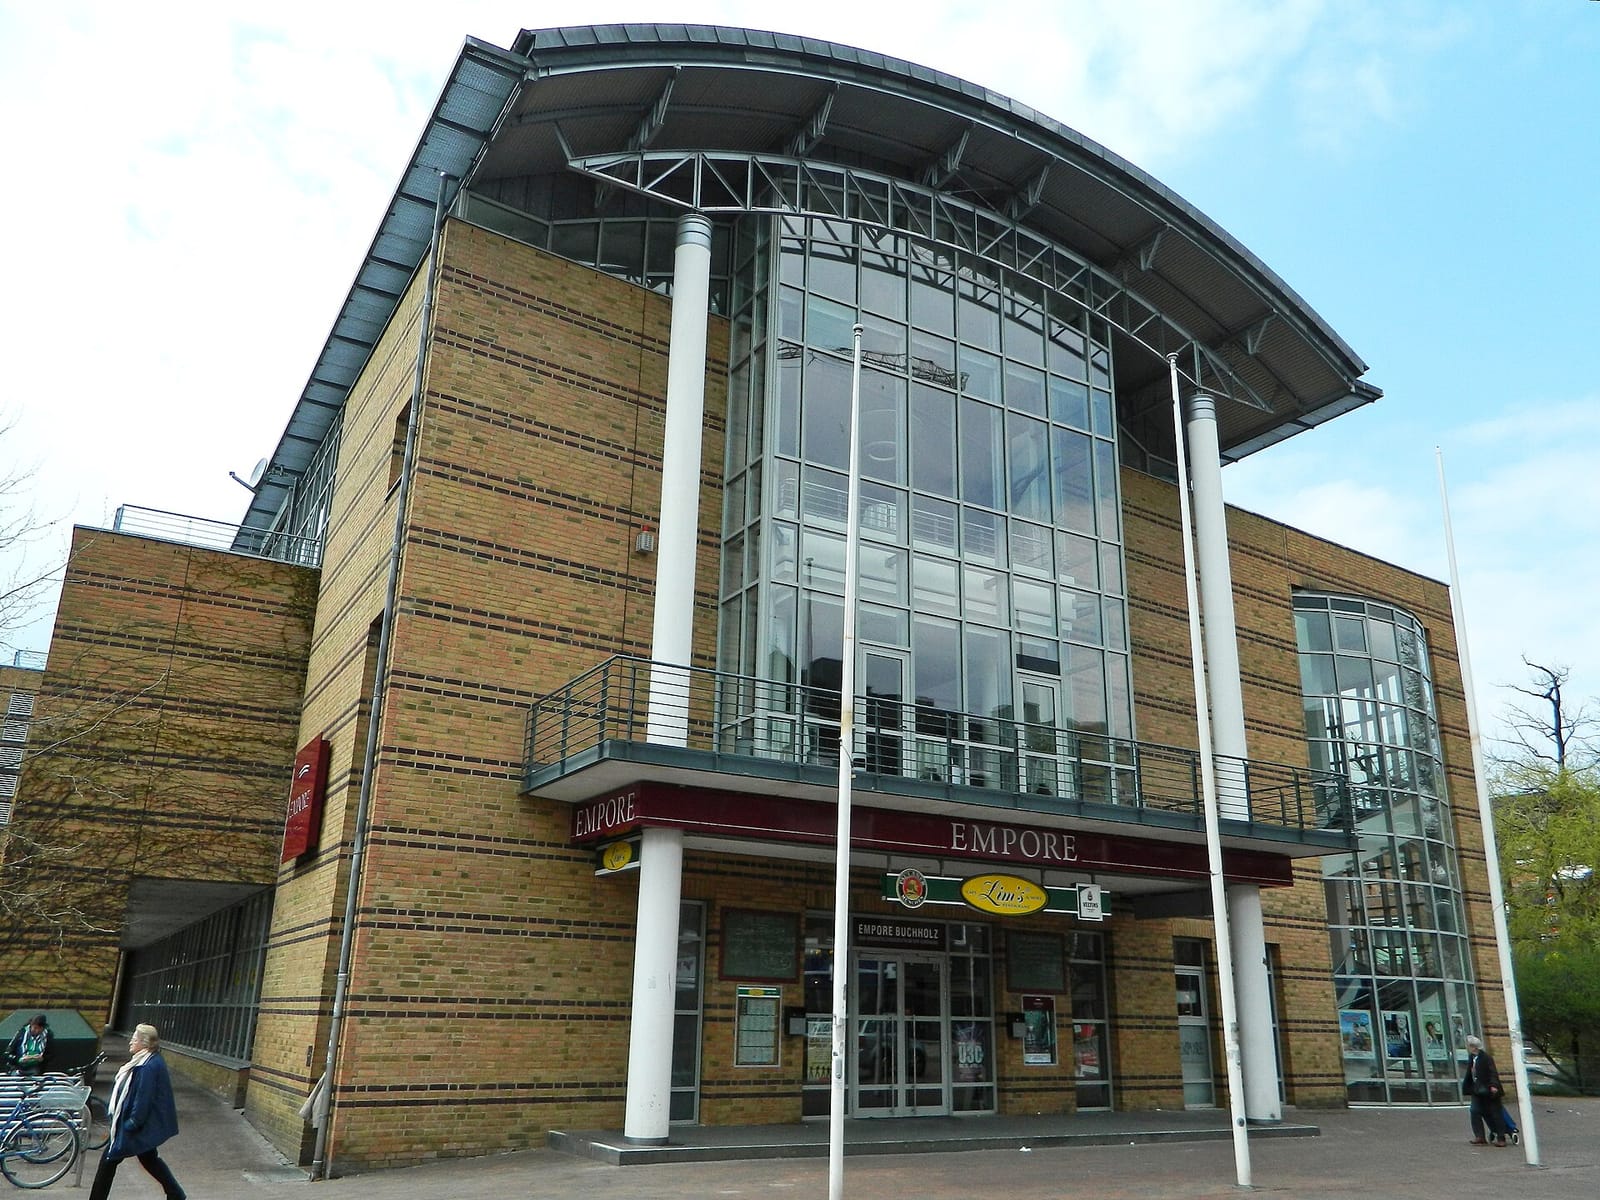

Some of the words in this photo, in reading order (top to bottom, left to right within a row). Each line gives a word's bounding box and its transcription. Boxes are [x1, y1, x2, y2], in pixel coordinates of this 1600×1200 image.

[576, 792, 635, 836] EMPORE
[950, 822, 1078, 861] EMPORE
[979, 880, 1025, 907] Lim's
[858, 924, 893, 936] EMPORE
[895, 926, 939, 939] BUCHHOLZ
